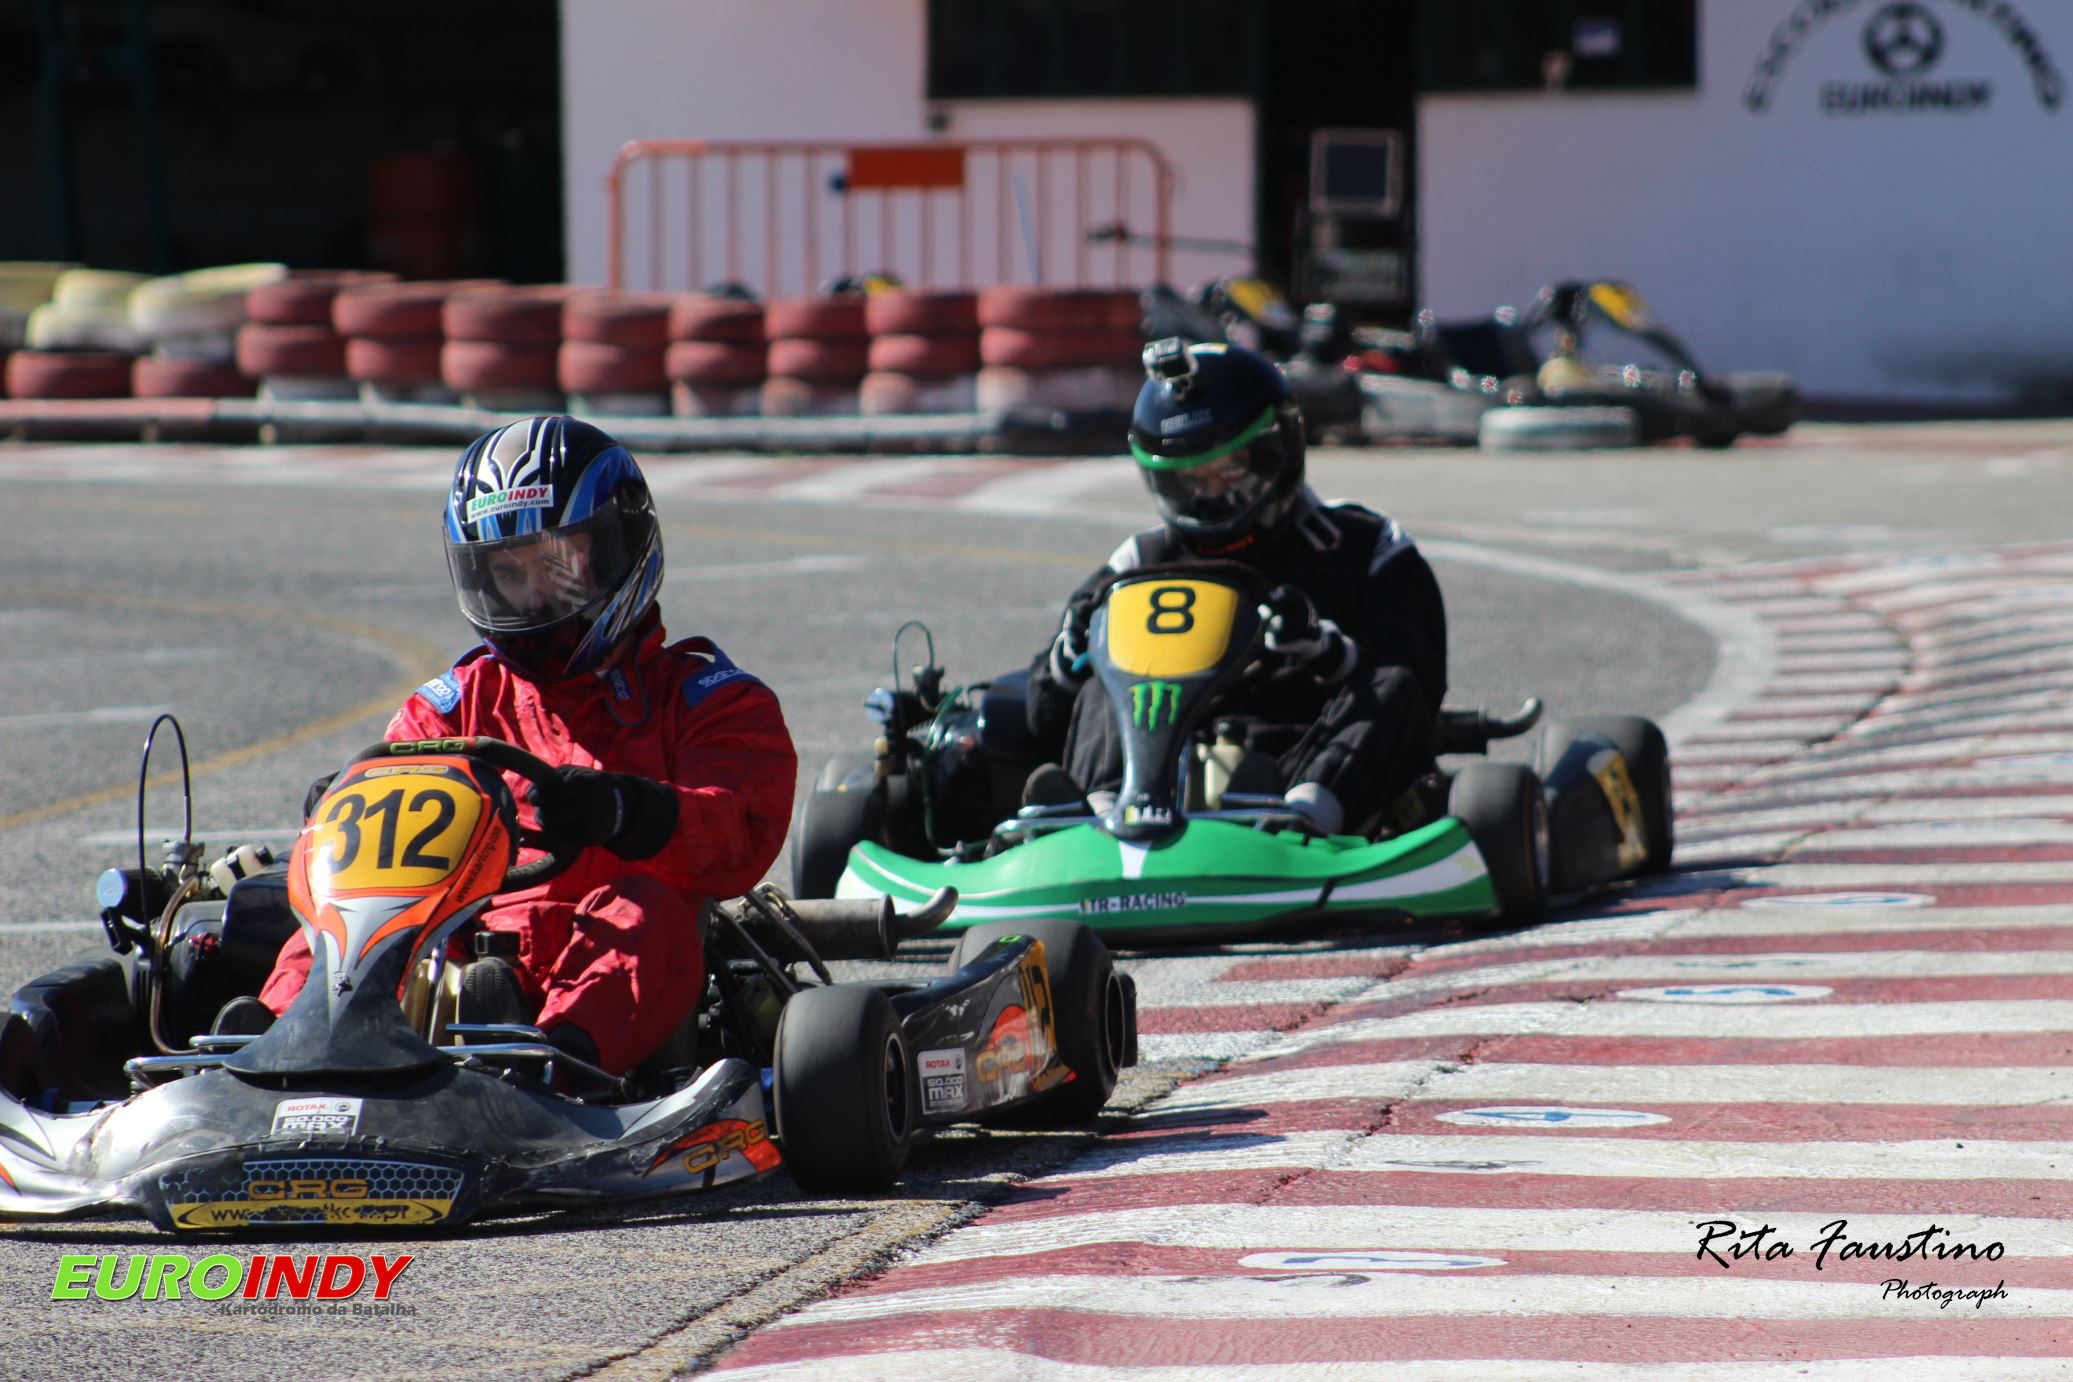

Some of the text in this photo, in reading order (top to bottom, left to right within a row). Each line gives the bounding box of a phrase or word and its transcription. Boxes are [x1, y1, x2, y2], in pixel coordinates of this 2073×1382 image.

[471, 487, 548, 511] EUROINDY
[1145, 586, 1196, 634] 8
[325, 788, 457, 874] 312
[247, 1178, 369, 1200] CRG
